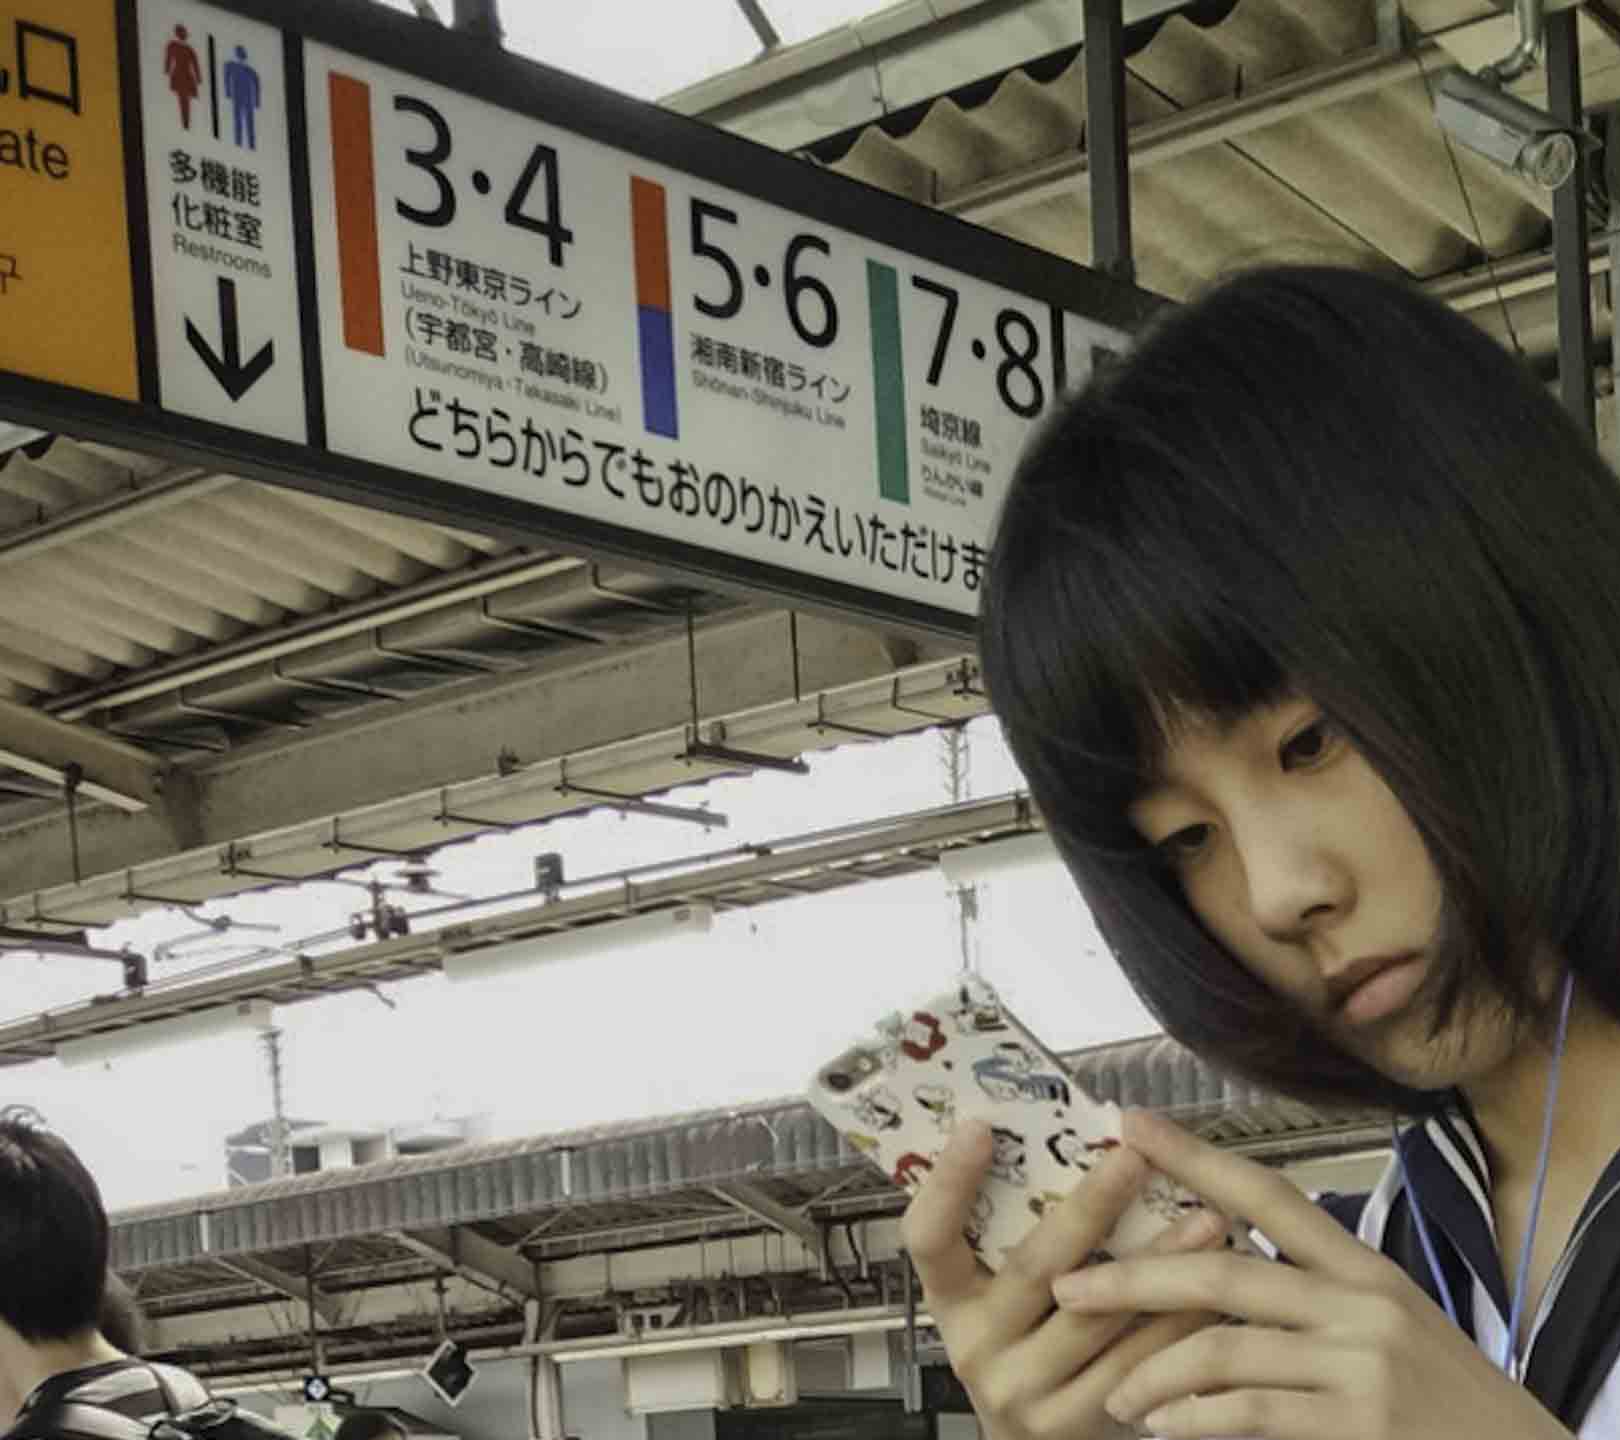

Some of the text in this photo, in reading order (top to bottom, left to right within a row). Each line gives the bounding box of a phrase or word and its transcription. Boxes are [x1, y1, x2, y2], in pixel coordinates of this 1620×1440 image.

[0, 19, 81, 116] 口
[170, 149, 261, 208] 多機能
[172, 192, 263, 249] 化粧室
[173, 232, 272, 278] Restrooms
[399, 240, 581, 319] 上野東京ライン
[503, 311, 536, 336] Line
[690, 332, 850, 404] 湘南新宿ライン
[816, 407, 846, 429] Line
[921, 403, 982, 448] 埼京線
[966, 453, 991, 476] Line
